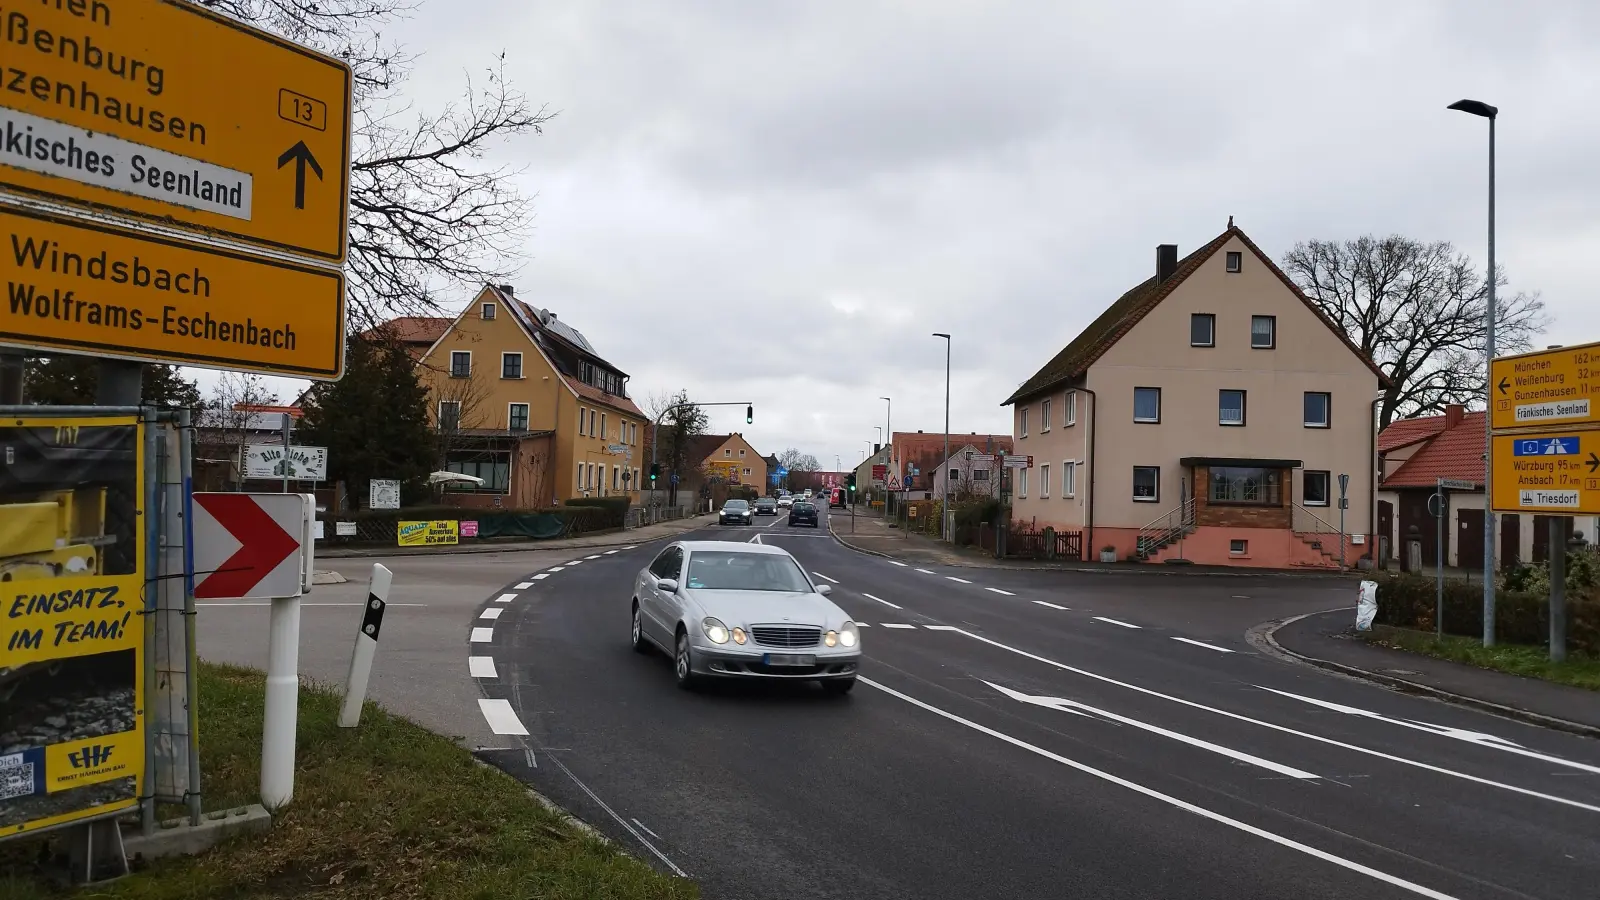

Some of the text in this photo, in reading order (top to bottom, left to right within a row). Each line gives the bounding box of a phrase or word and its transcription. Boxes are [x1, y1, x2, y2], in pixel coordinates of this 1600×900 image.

[43, 0, 111, 27] en
[0, 7, 164, 96] ßenburg
[0, 68, 207, 145] zenhausen
[293, 98, 313, 122] 13
[130, 154, 242, 209] Seenland
[11, 233, 211, 298] Windsbach
[8, 281, 296, 351] Wolframs-Eschenbach
[1514, 360, 1551, 373] München
[1574, 352, 1589, 365] 162
[1514, 373, 1565, 387] Weißenburg
[1577, 368, 1589, 379] 32
[1514, 386, 1577, 400] Gunzenhausen
[1581, 383, 1588, 394] 11
[1501, 401, 1508, 409] 13
[1517, 403, 1588, 418] Fränkisches Seenland
[1528, 443, 1533, 452] 6
[1513, 459, 1580, 472] Würzburg 95 km
[1518, 475, 1580, 485] Ansbach 17 km
[1589, 480, 1597, 489] 13
[1537, 493, 1577, 504] Triesdorf
[8, 586, 124, 618] EINSATZ,
[8, 611, 130, 651] IM TEAM!
